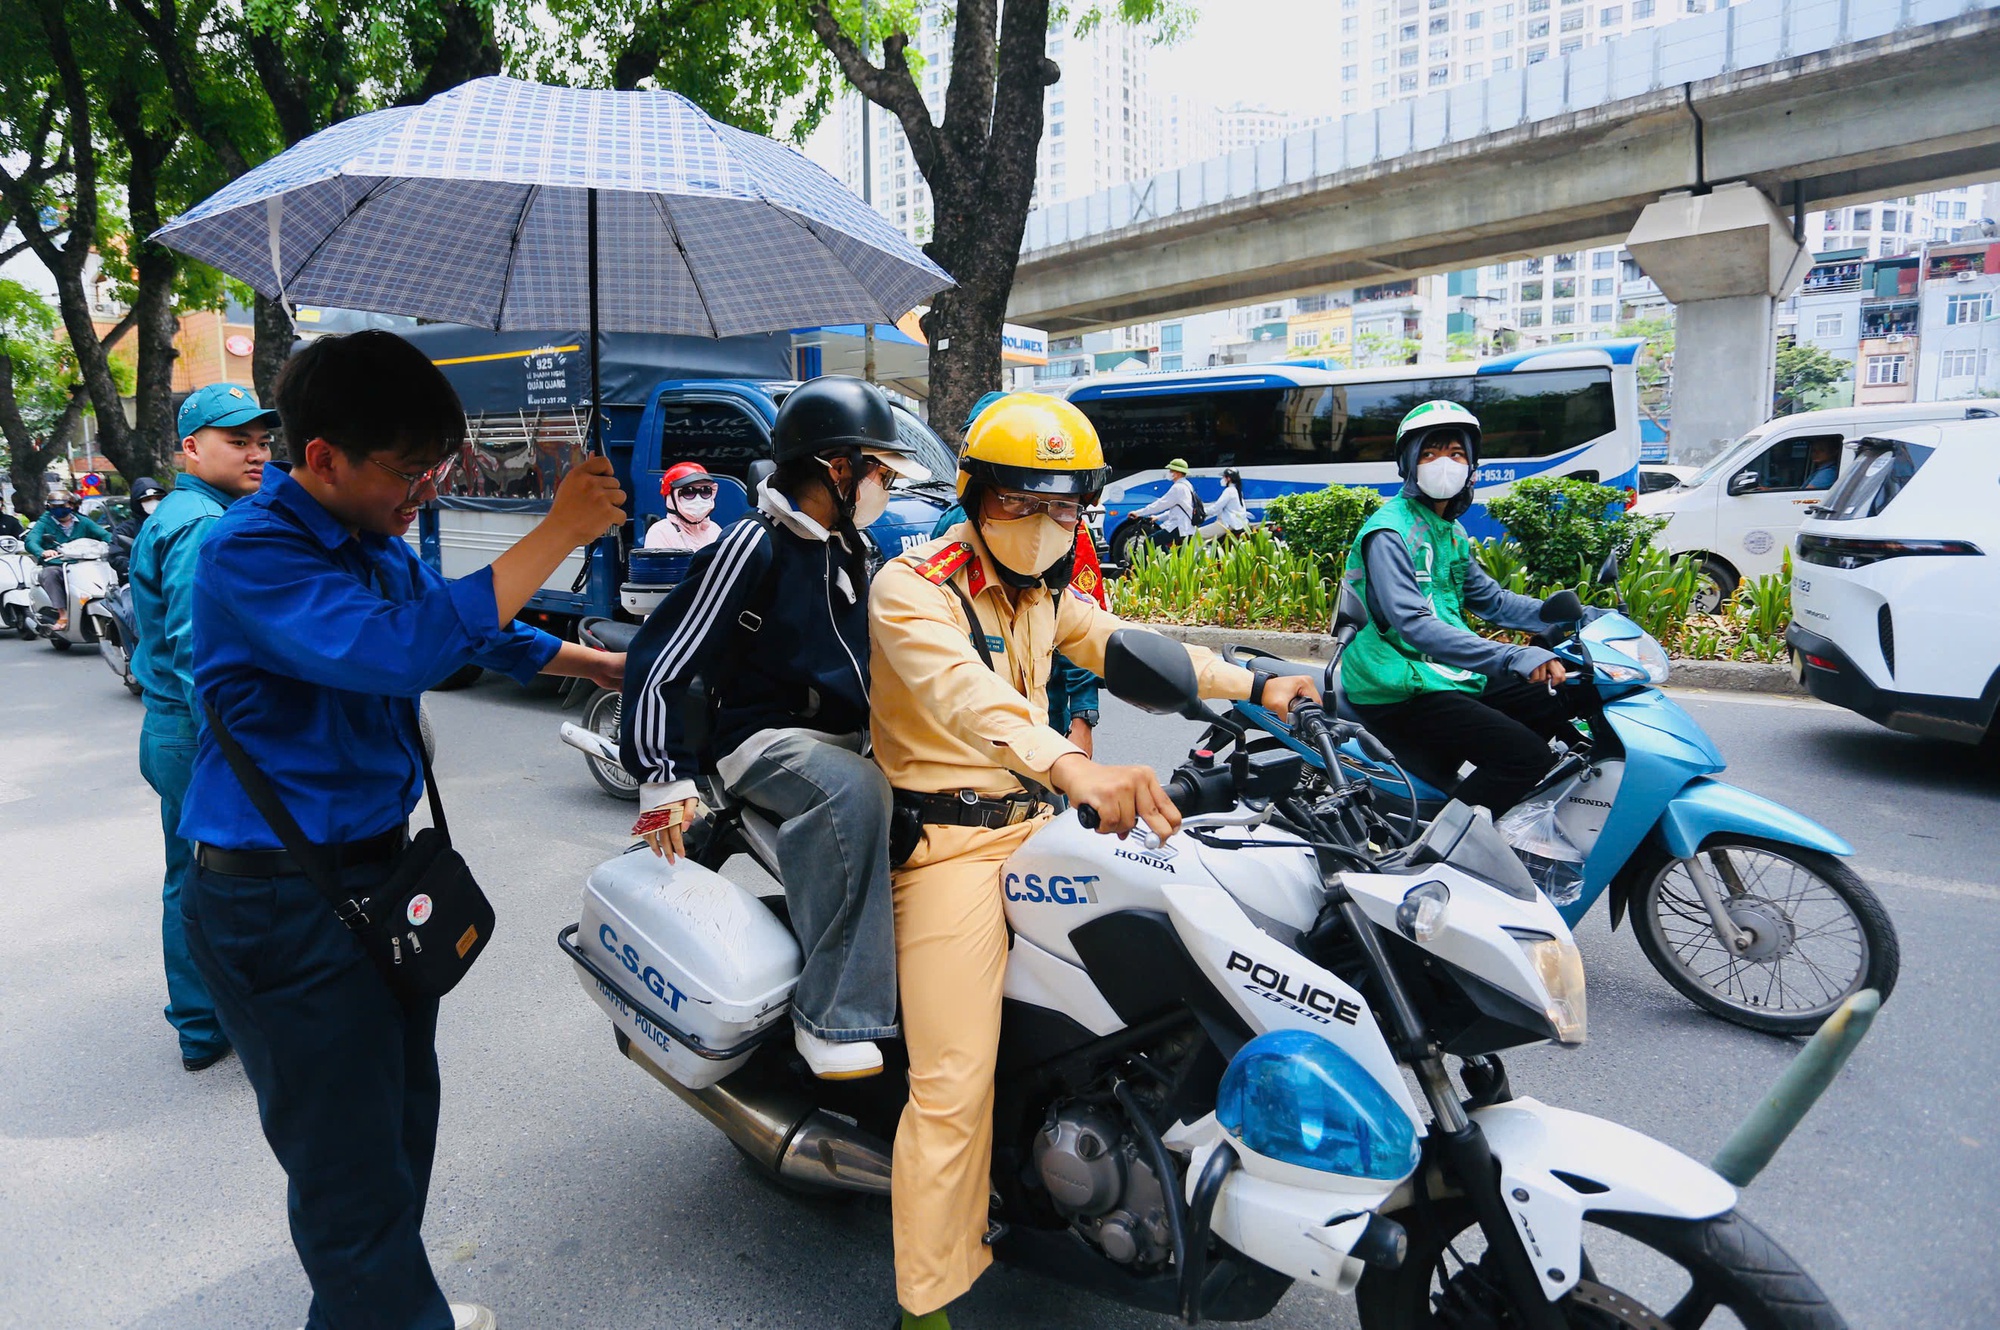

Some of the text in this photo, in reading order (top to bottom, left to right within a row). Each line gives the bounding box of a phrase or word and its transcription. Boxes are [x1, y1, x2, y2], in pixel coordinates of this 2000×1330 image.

[536, 357, 553, 370] 925
[1568, 796, 1613, 809] HONDA
[1113, 847, 1177, 875] HONDA
[1004, 872, 1101, 905] C.S.G.T
[598, 923, 688, 1013] C.S.G.T
[595, 978, 630, 1017] TRAFFIC
[1225, 950, 1362, 1027] POLICE
[635, 1011, 671, 1053] POLICE
